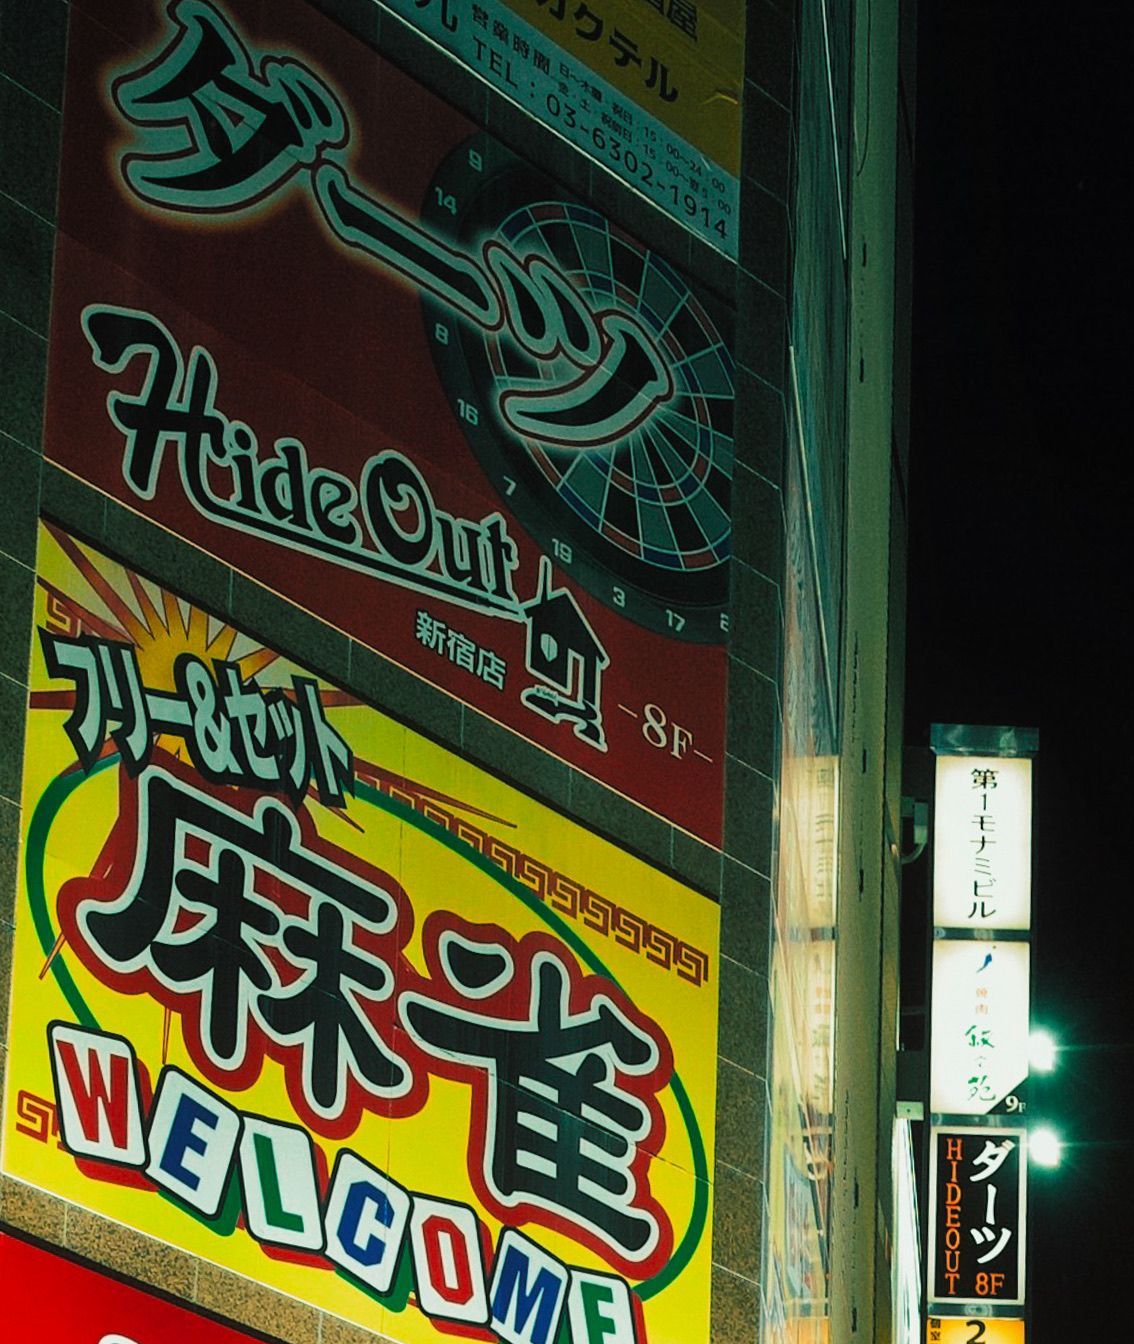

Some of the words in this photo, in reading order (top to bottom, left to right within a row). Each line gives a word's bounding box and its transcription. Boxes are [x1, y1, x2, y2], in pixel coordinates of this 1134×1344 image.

[472, 3, 550, 75] 営業時間
[113, 0, 675, 447] ダーツ
[415, 610, 507, 692] 新宿店
[86, 772, 660, 1262] 麻雀
[1004, 1095, 1028, 1115] 9F
[944, 1136, 964, 1296] HIDEOUT
[968, 1138, 1017, 1266] ダーツ
[974, 1272, 1006, 1298] 8F
